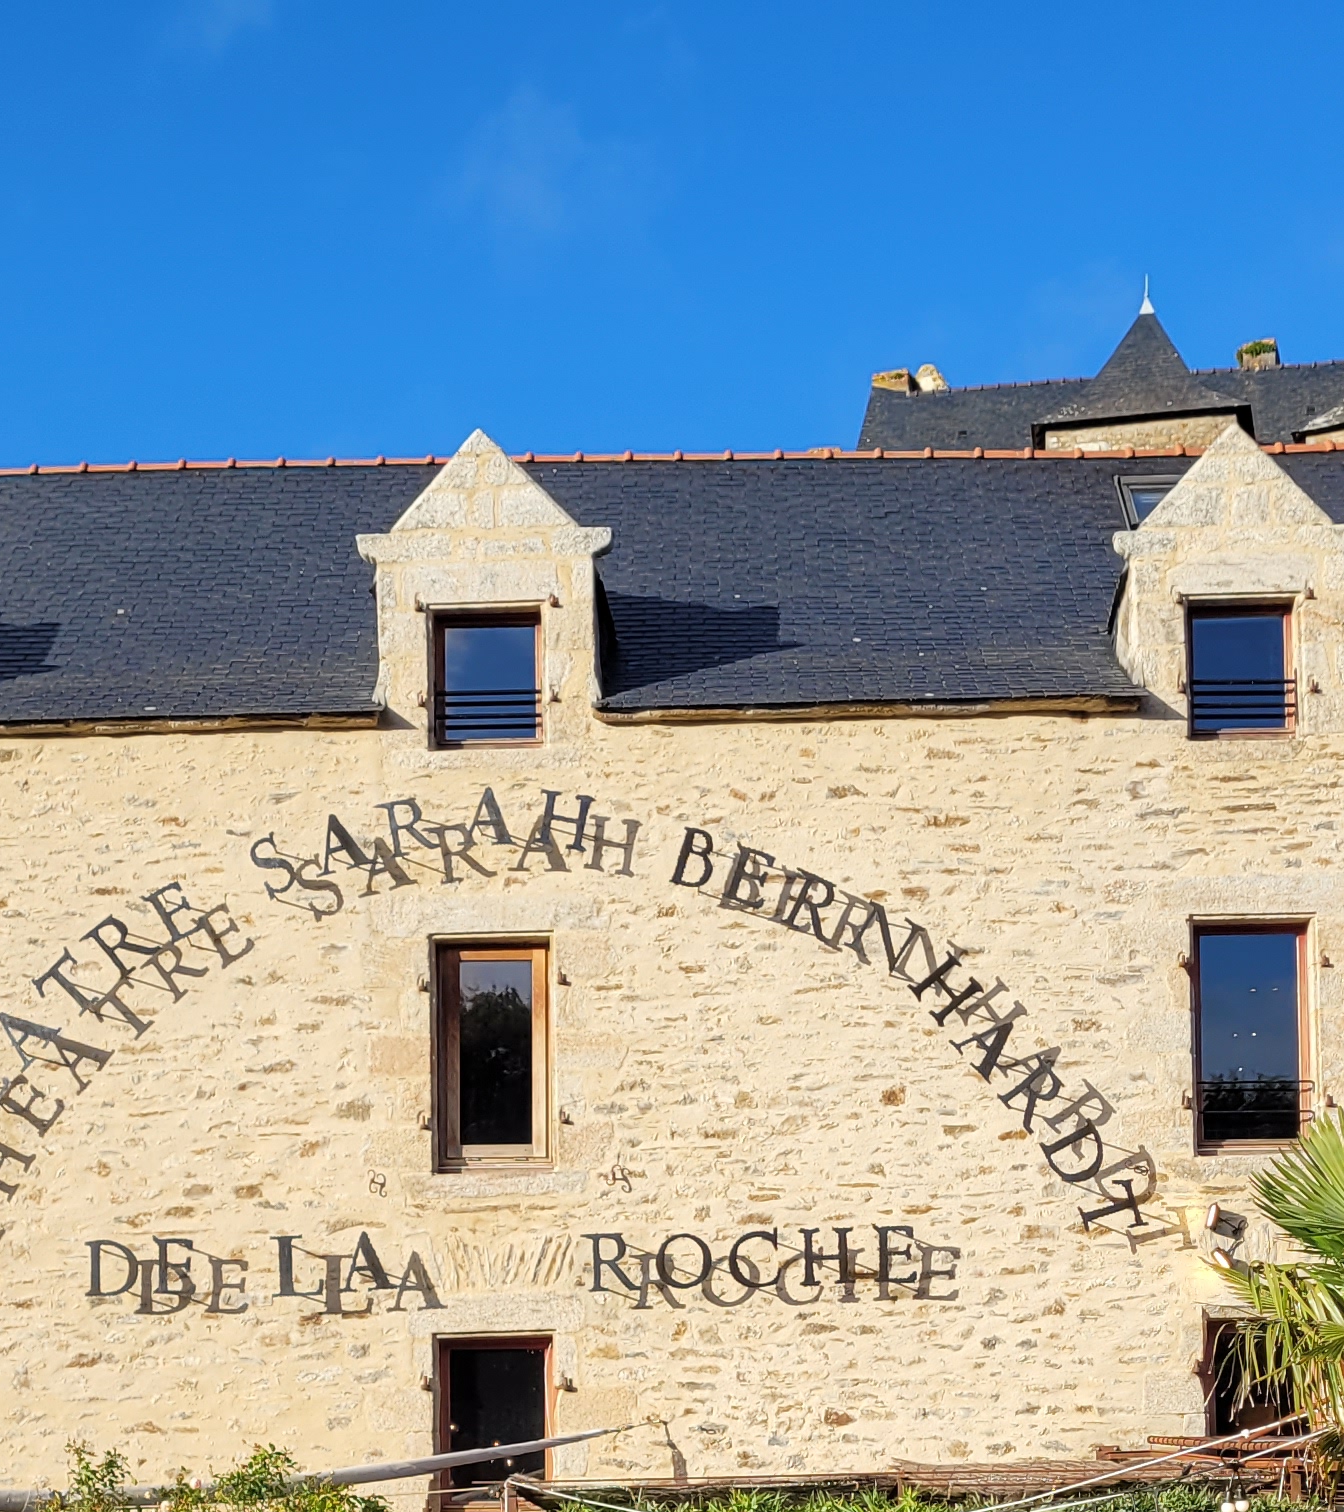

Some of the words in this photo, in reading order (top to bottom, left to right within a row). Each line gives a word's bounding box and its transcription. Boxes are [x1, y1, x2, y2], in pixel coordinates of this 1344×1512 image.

[250, 787, 595, 900] SARAH
[669, 826, 1150, 1233] BERNHARDT
[85, 1234, 195, 1298] DE
[270, 1230, 400, 1298] LA
[582, 1223, 921, 1293] ROCHE
